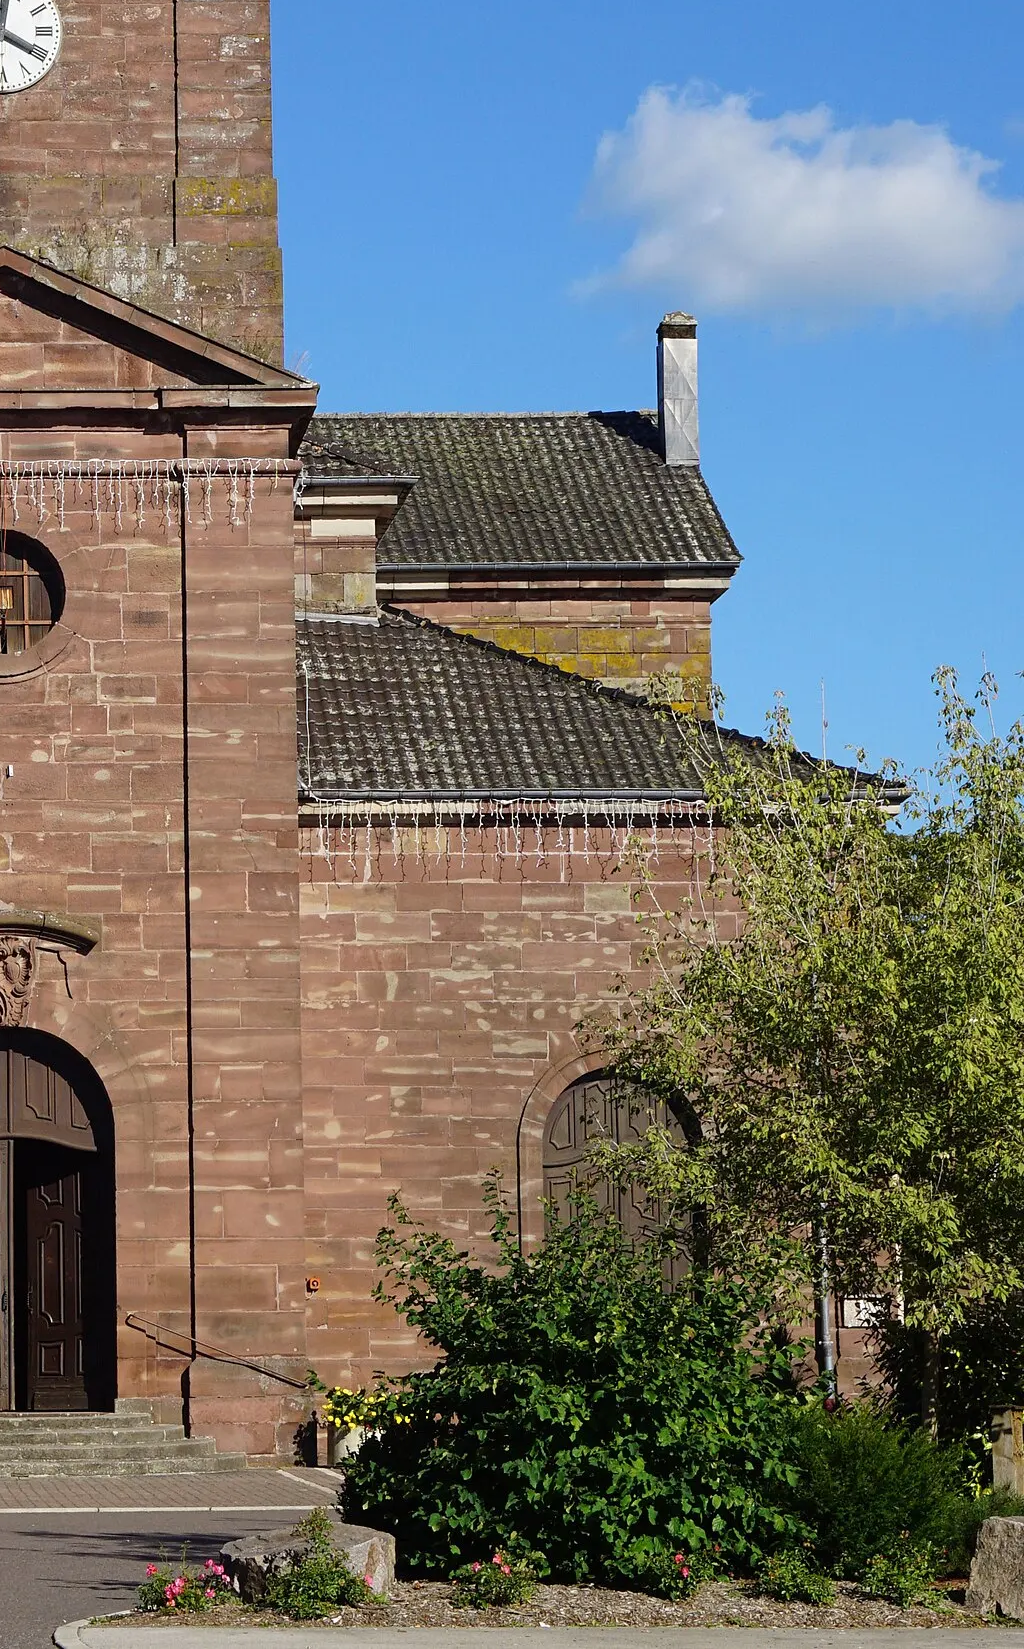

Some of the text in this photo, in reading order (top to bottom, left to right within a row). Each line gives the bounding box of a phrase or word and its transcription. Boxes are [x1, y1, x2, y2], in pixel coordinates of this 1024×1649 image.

[29, 3, 47, 17] II
[35, 26, 53, 37] III
[19, 61, 32, 78] V
